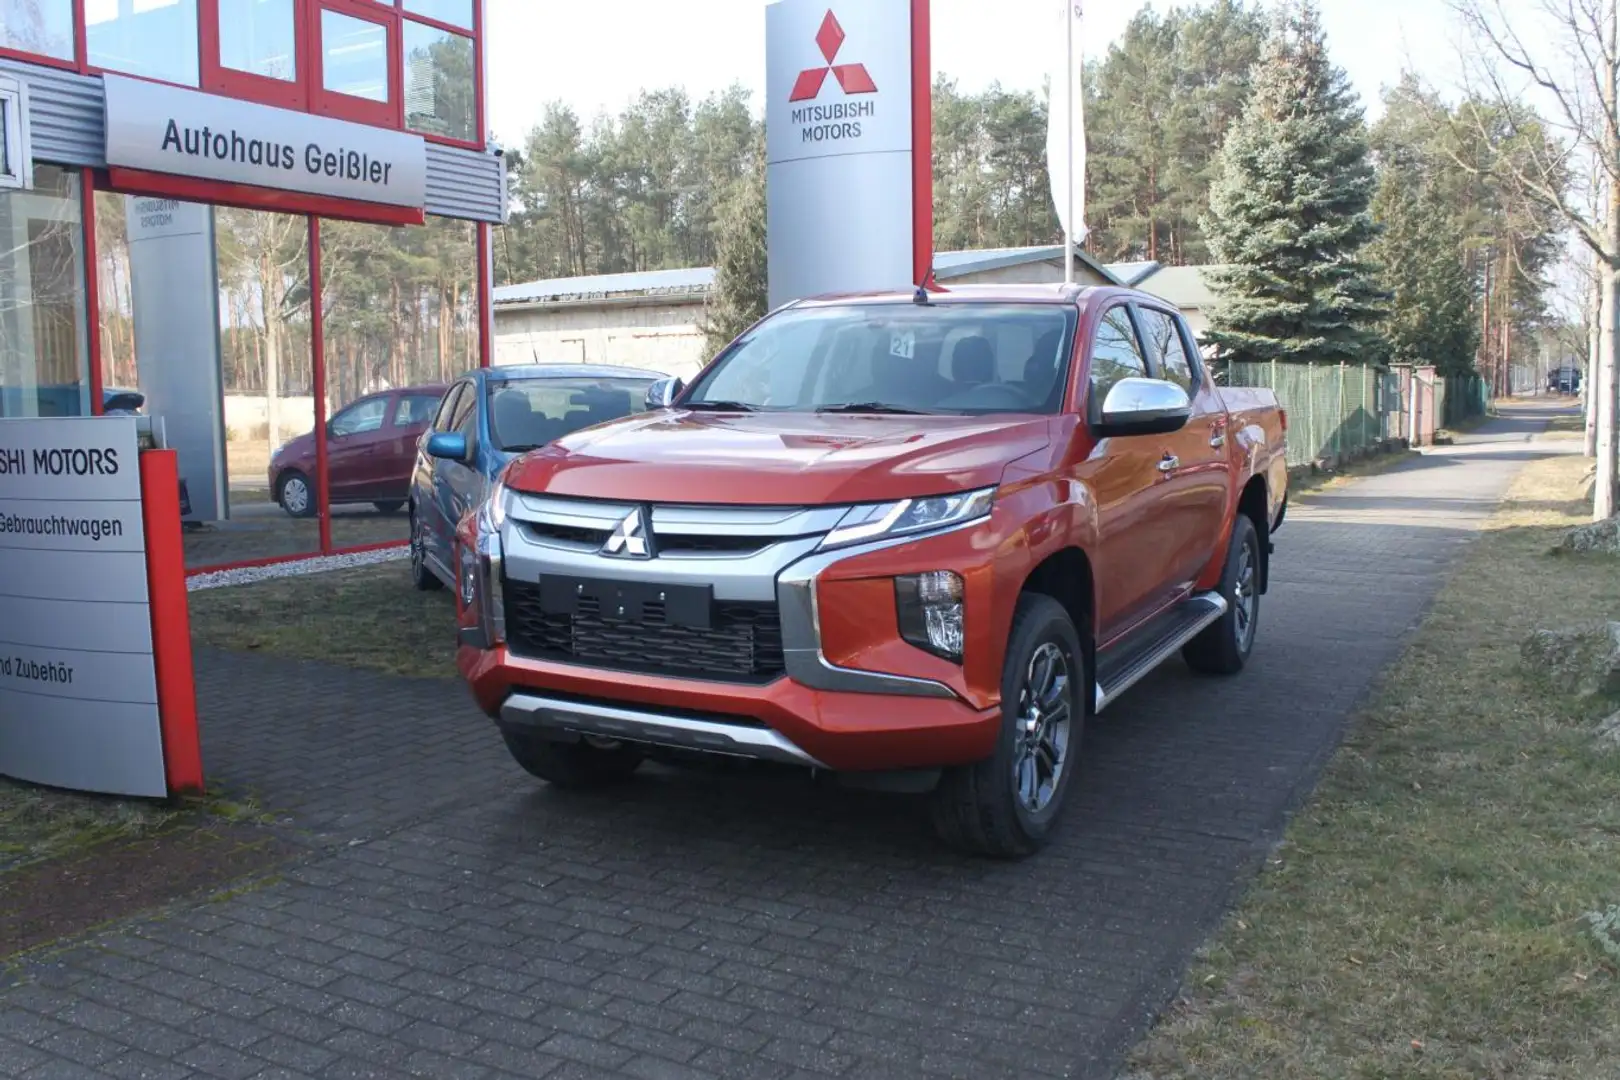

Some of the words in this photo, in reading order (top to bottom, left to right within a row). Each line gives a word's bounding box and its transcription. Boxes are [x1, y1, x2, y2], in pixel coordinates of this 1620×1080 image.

[791, 101, 875, 124] MITSUBISHI
[802, 122, 862, 142] MOTORS
[161, 118, 295, 170] Autohaus
[304, 143, 392, 186] Geißler
[33, 448, 119, 476] MOTORS
[15, 657, 74, 684] Zubehör
